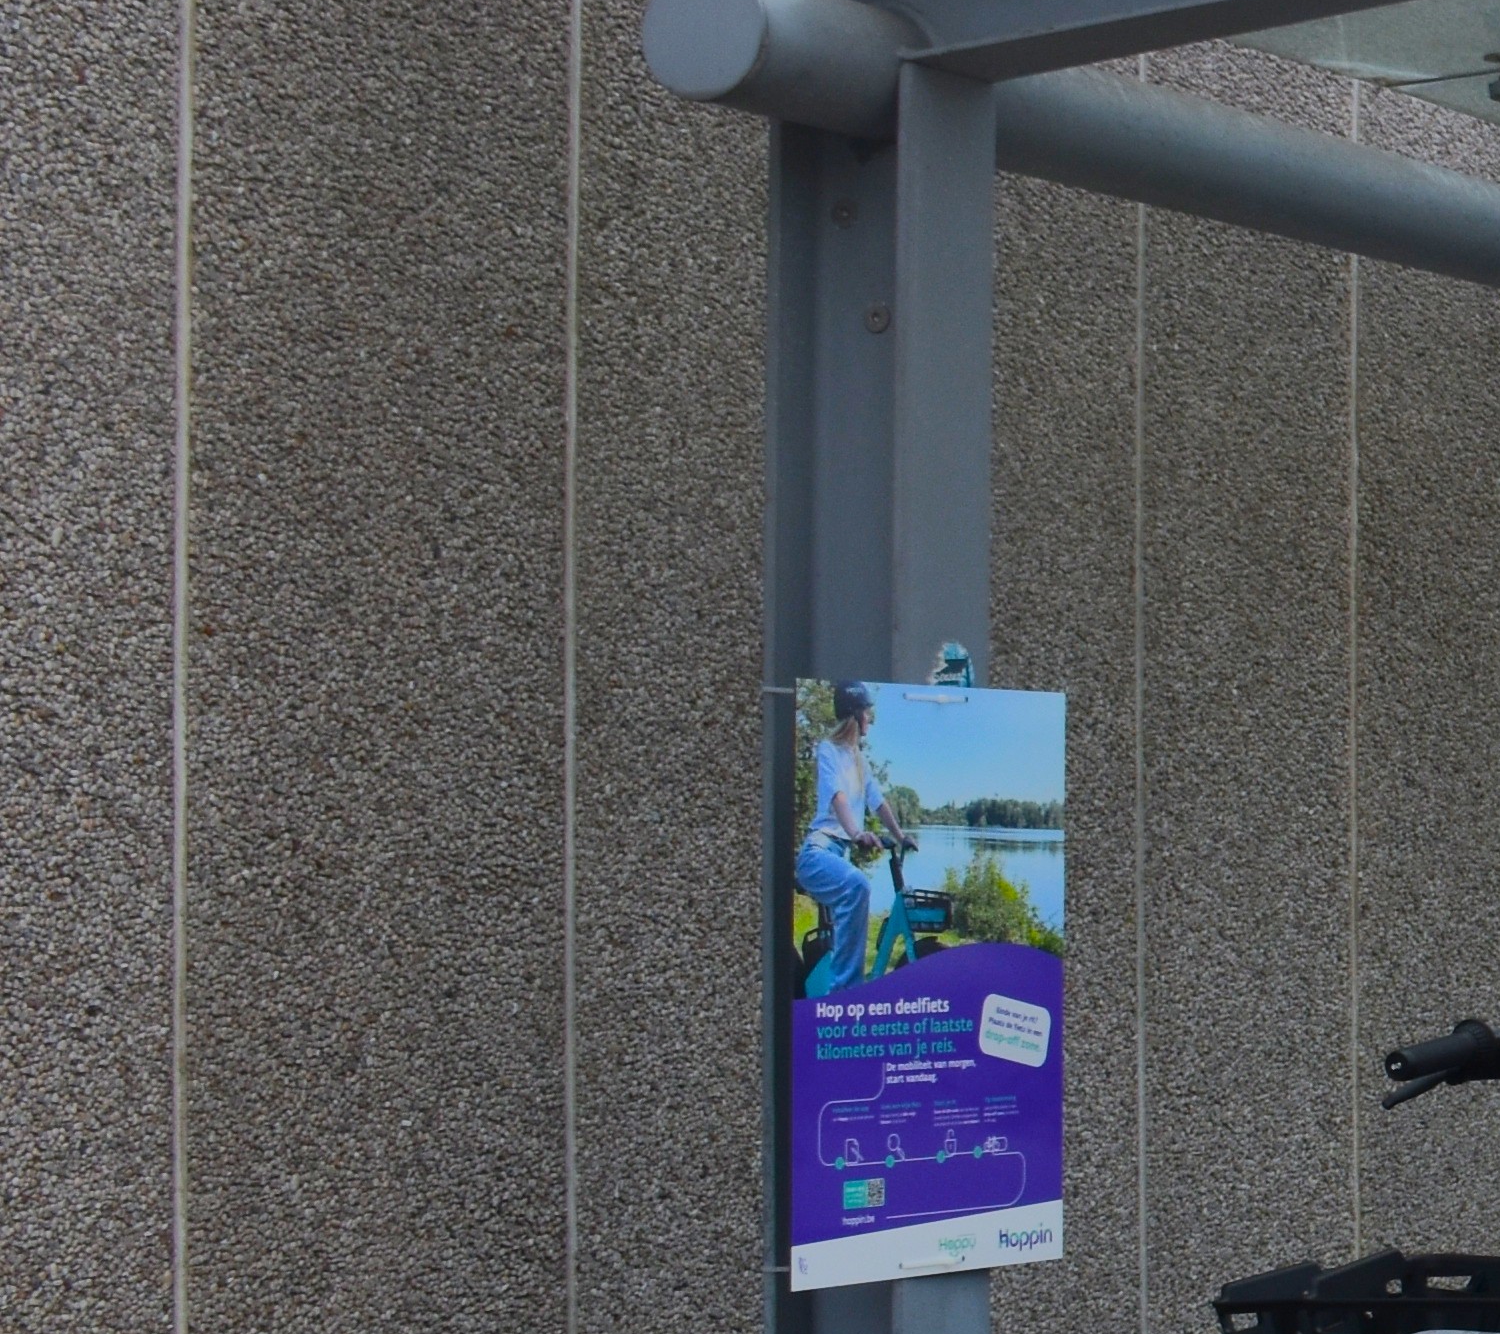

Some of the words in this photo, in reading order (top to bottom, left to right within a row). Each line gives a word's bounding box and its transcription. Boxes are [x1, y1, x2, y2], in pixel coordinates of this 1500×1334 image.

[816, 1002, 844, 1022] Hop
[847, 1003, 865, 1021] op
[868, 1003, 892, 1016] een
[895, 997, 950, 1015] deelfiets
[817, 1025, 848, 1039] voor
[851, 1022, 867, 1037] de
[871, 1021, 910, 1036] eerste
[913, 1018, 928, 1033] of
[930, 1018, 974, 1033] laatste
[817, 1042, 885, 1060] kilometers
[889, 1043, 912, 1057] van
[915, 1037, 927, 1059] je
[931, 1037, 957, 1053] reis.
[998, 1223, 1053, 1251] Hoppin
